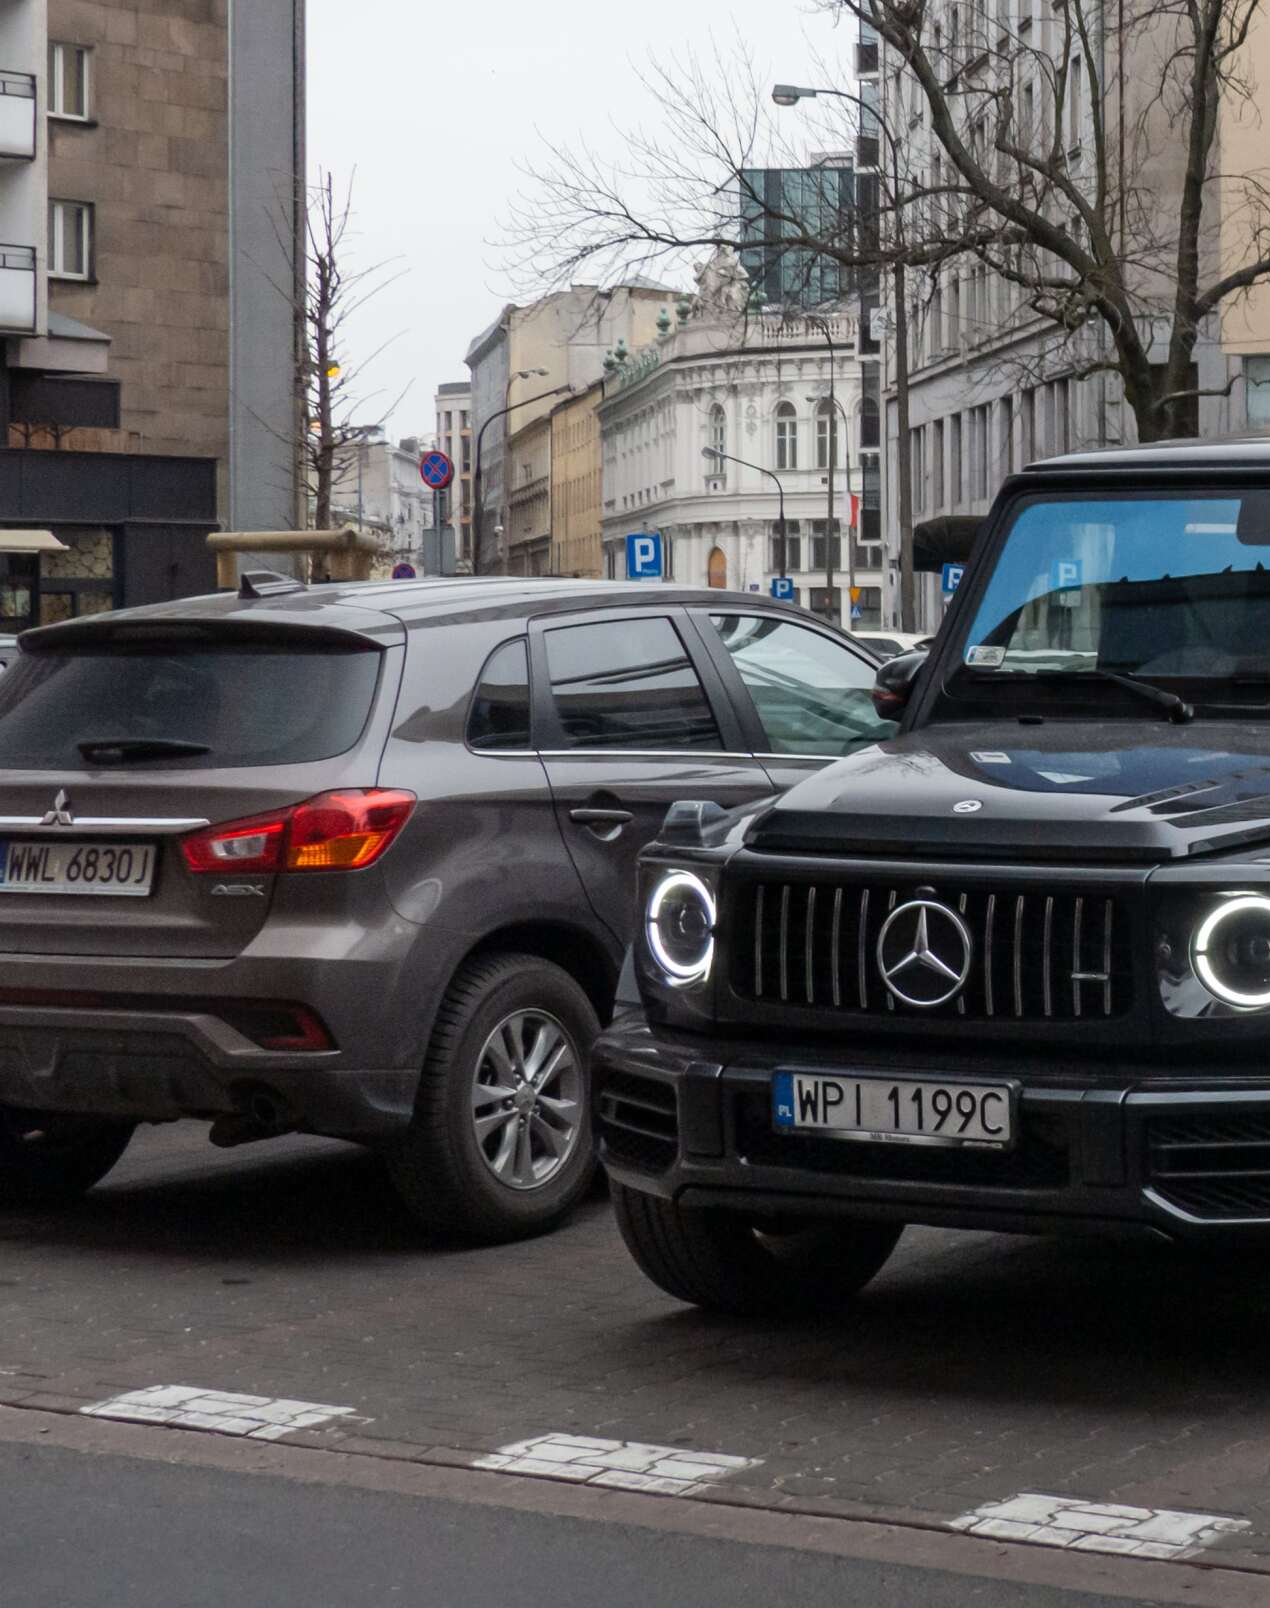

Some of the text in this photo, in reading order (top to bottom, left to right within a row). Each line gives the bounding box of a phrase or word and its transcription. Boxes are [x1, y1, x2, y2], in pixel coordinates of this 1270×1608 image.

[634, 538, 655, 572] P
[777, 580, 790, 598] P
[8, 846, 149, 884] WWL 6830J
[210, 884, 265, 896] ASX
[778, 1105, 792, 1118] PL
[797, 1079, 1004, 1135] WPI 1199C
